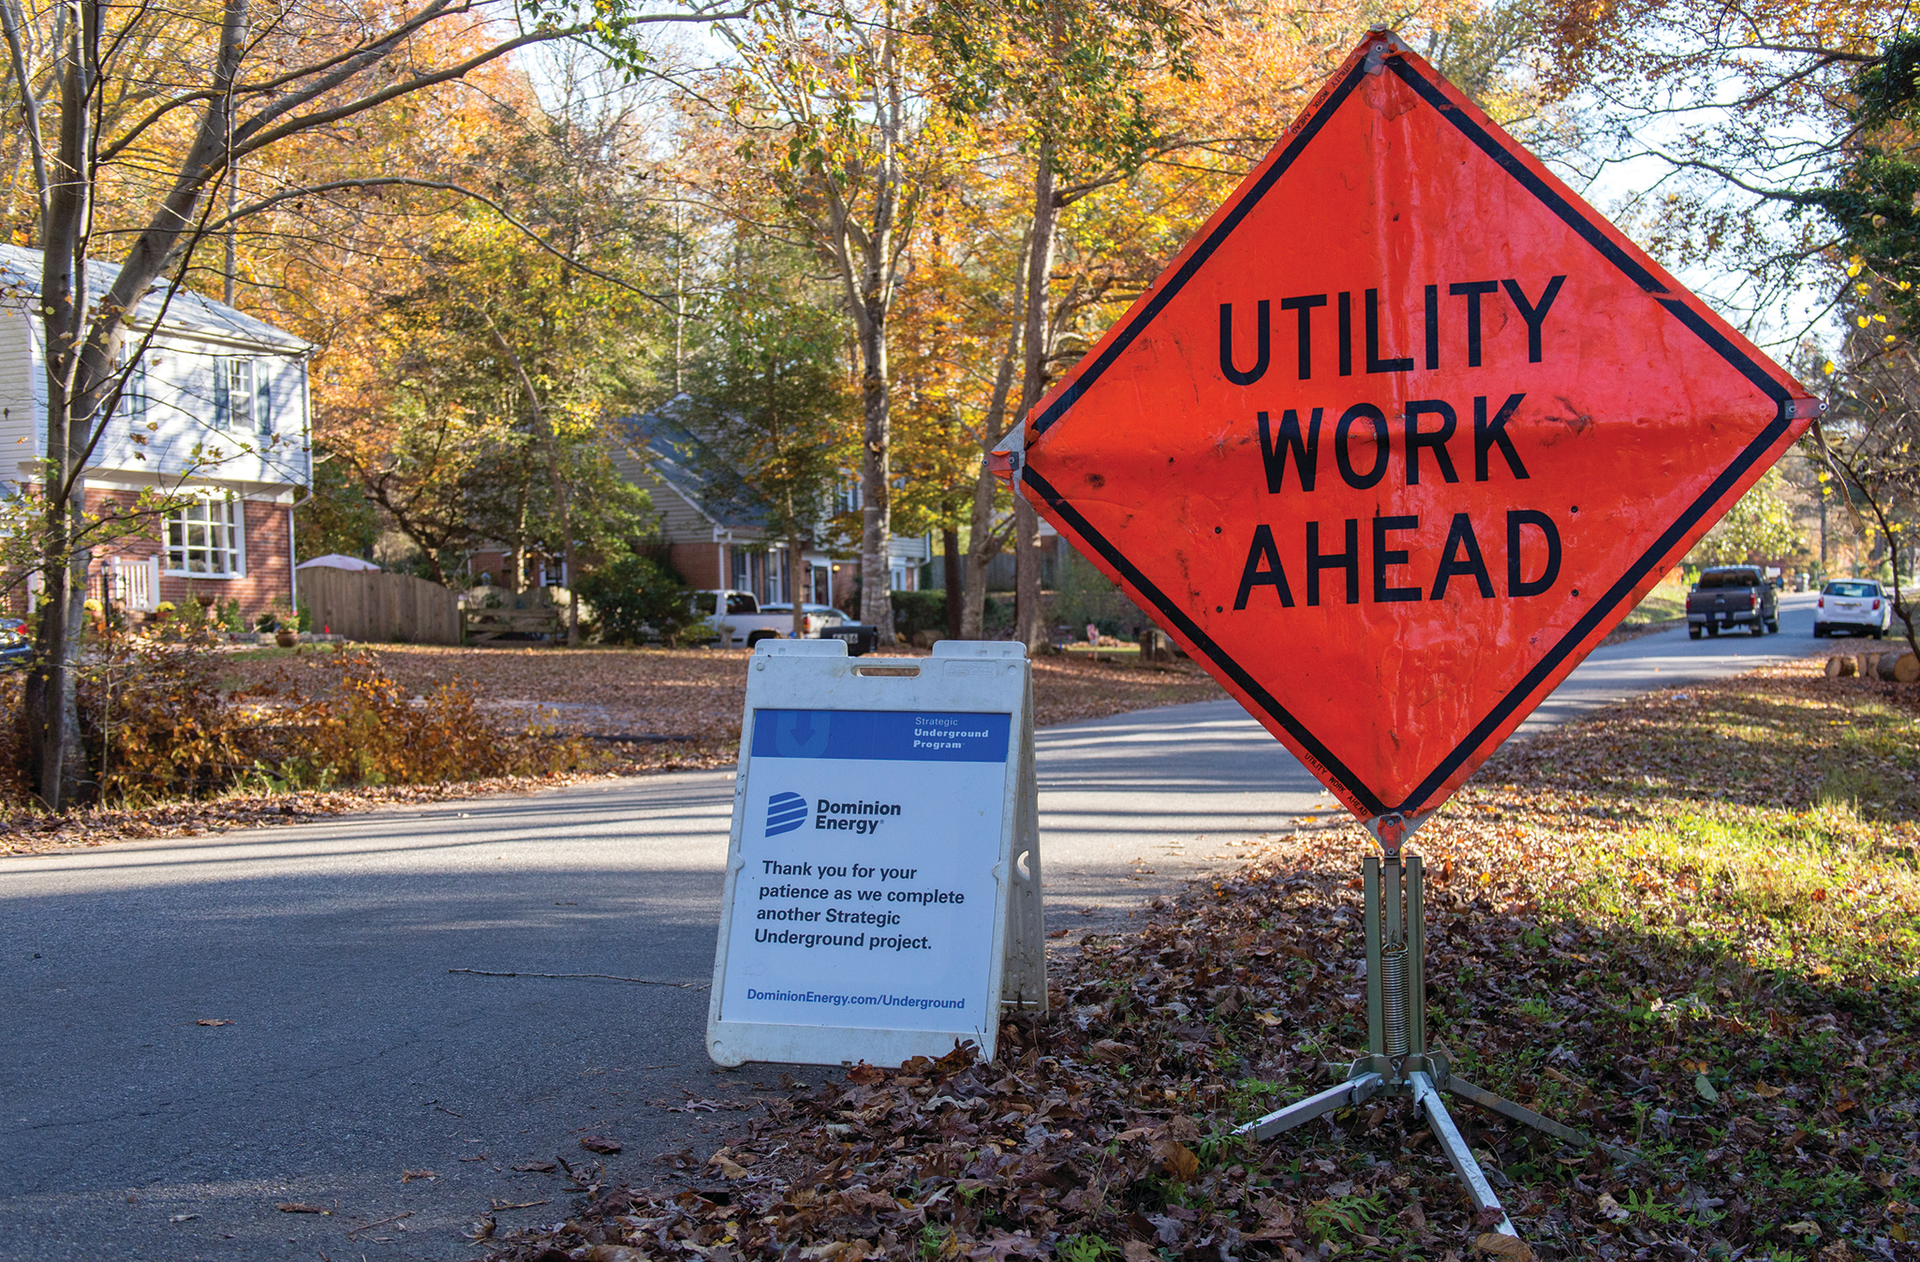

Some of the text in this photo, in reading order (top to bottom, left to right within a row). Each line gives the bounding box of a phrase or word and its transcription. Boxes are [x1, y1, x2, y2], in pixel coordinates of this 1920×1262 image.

[1291, 63, 1353, 134] UTILITY WORK AHEAD
[1219, 275, 1567, 386] UTILITY
[1257, 393, 1531, 494] WORK
[1233, 509, 1562, 611] AHEAD
[914, 728, 989, 739] Underground
[915, 716, 959, 728] Strategic
[1304, 753, 1368, 816] UTILITY WORK AHEAD
[816, 799, 902, 816] Dominion
[762, 860, 918, 882] Thank you for your
[758, 884, 965, 907] patience as we complete
[756, 907, 901, 928] another Strategic
[754, 929, 932, 952] Underground project.
[747, 988, 965, 1011] DominionEnergy.com/Underground
